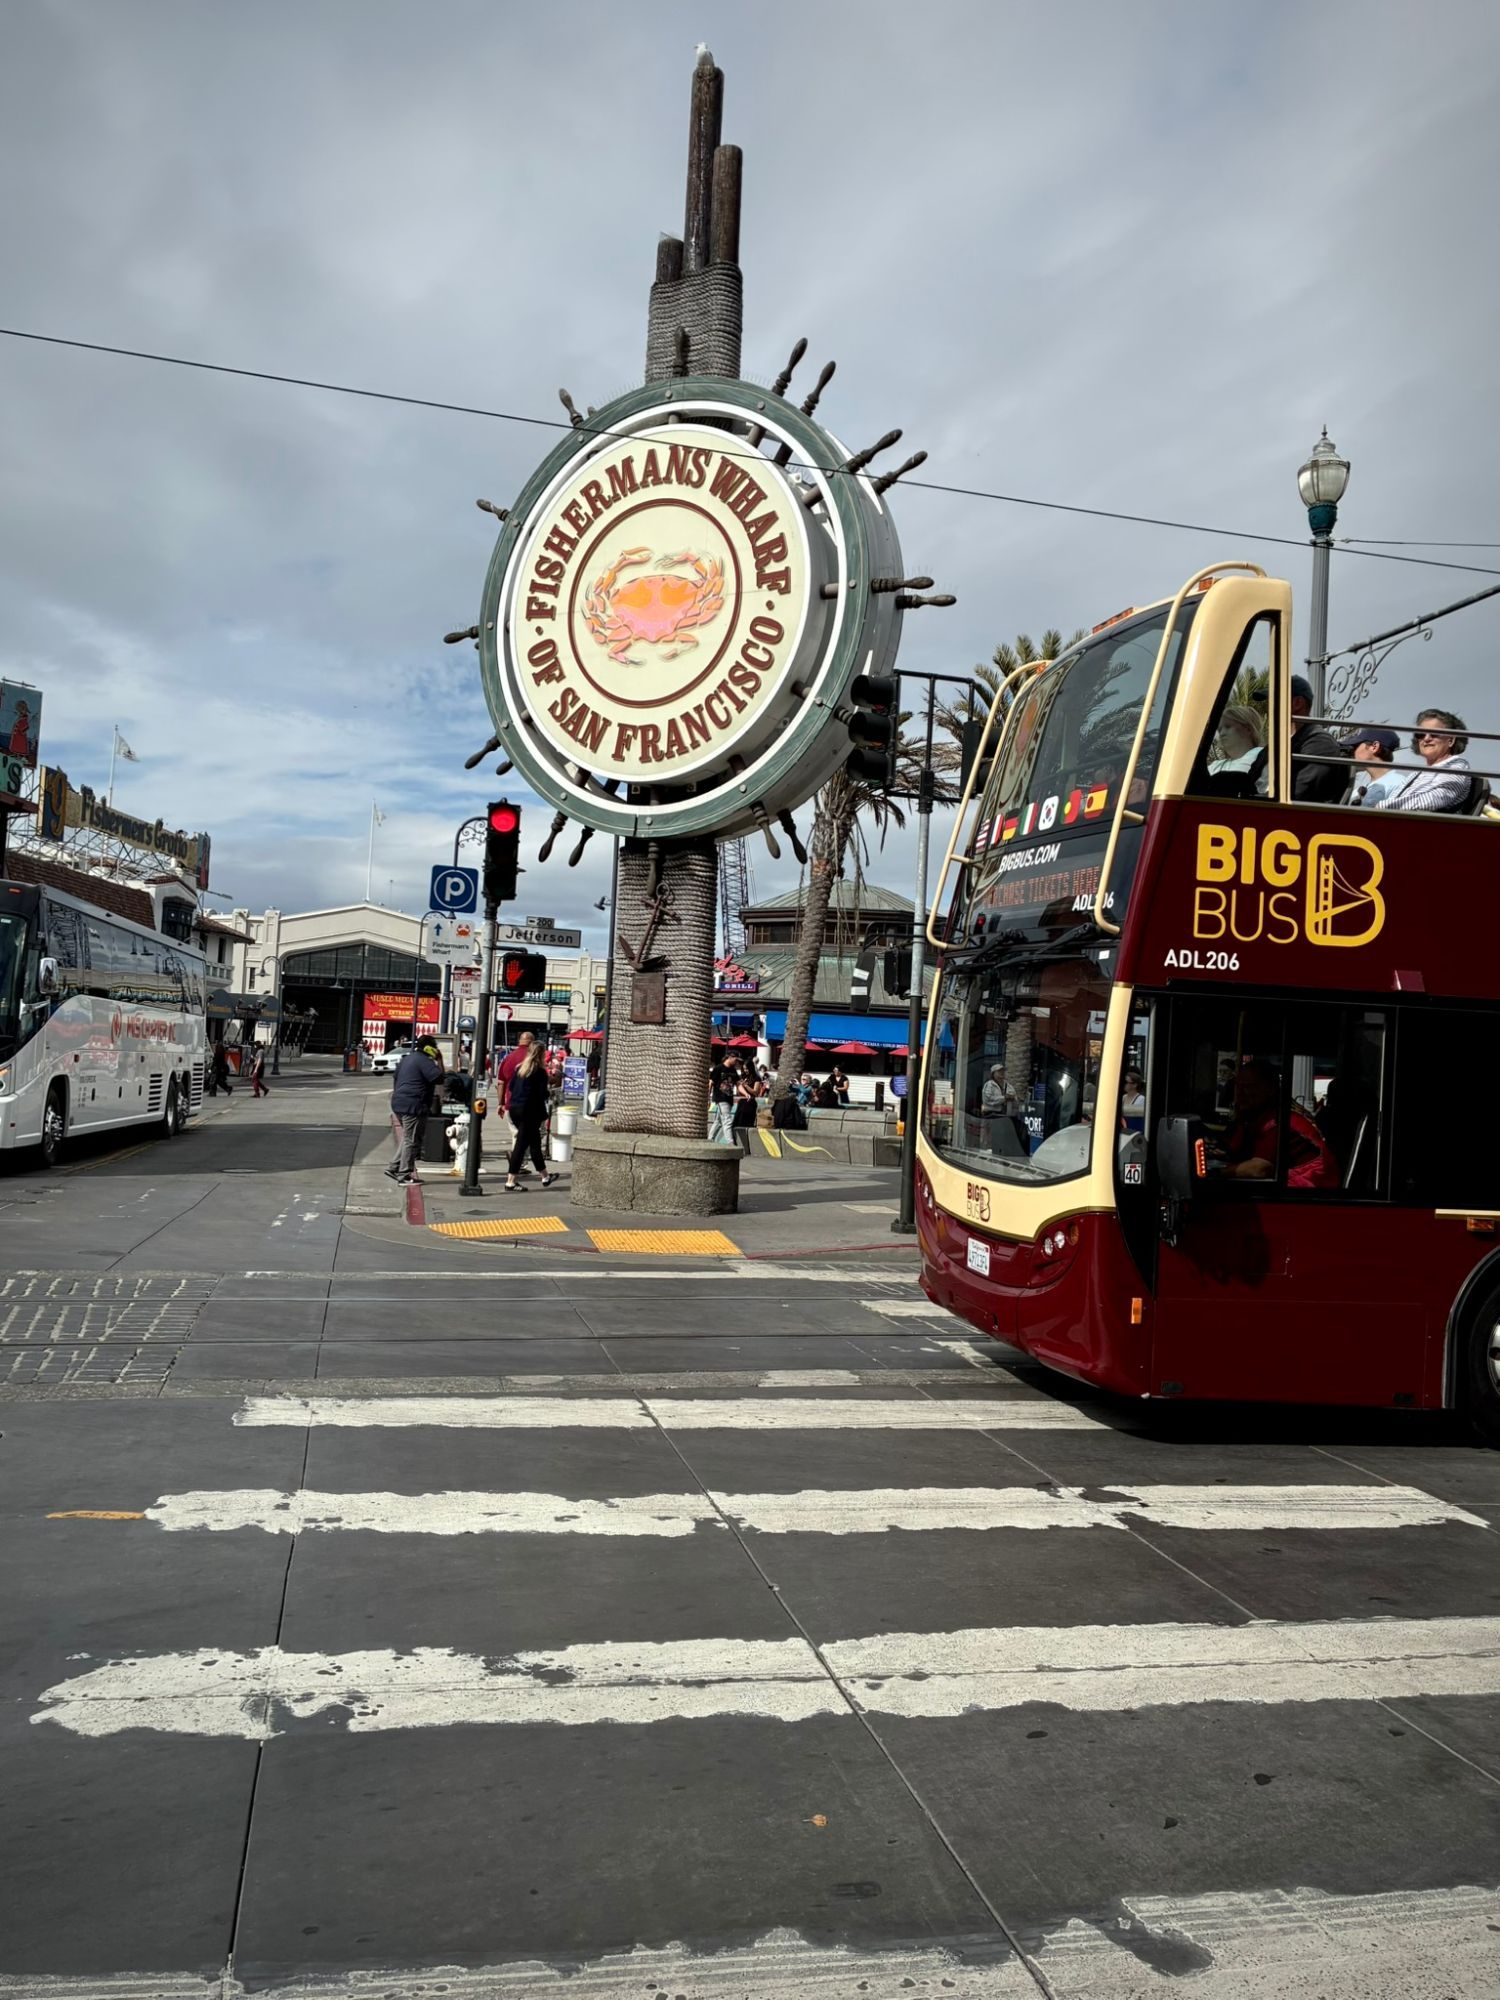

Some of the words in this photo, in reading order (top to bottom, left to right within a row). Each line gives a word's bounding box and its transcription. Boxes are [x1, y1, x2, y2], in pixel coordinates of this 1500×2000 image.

[525, 444, 713, 622] FISHERMANS
[708, 455, 792, 595] WHARF
[526, 638, 567, 688] OF
[547, 686, 613, 754] SAN
[611, 614, 786, 764] FRANCISCO
[154, 817, 188, 858] Grotto
[998, 842, 1062, 873] BIGBUS.COM
[1196, 823, 1301, 887] BIG
[444, 876, 466, 902] P
[1028, 871, 1070, 903] TICKETS
[1072, 865, 1100, 896] HERE
[1071, 891, 1115, 912] ADL06
[536, 918, 552, 927] 200
[1193, 886, 1298, 944] BUS
[432, 941, 470, 951] Fisherman's
[505, 929, 573, 945] Jefferson
[1164, 949, 1240, 971] ADL206
[1125, 1168, 1140, 1183] 40
[967, 1182, 979, 1202] BIG
[967, 1200, 980, 1219] BUS
